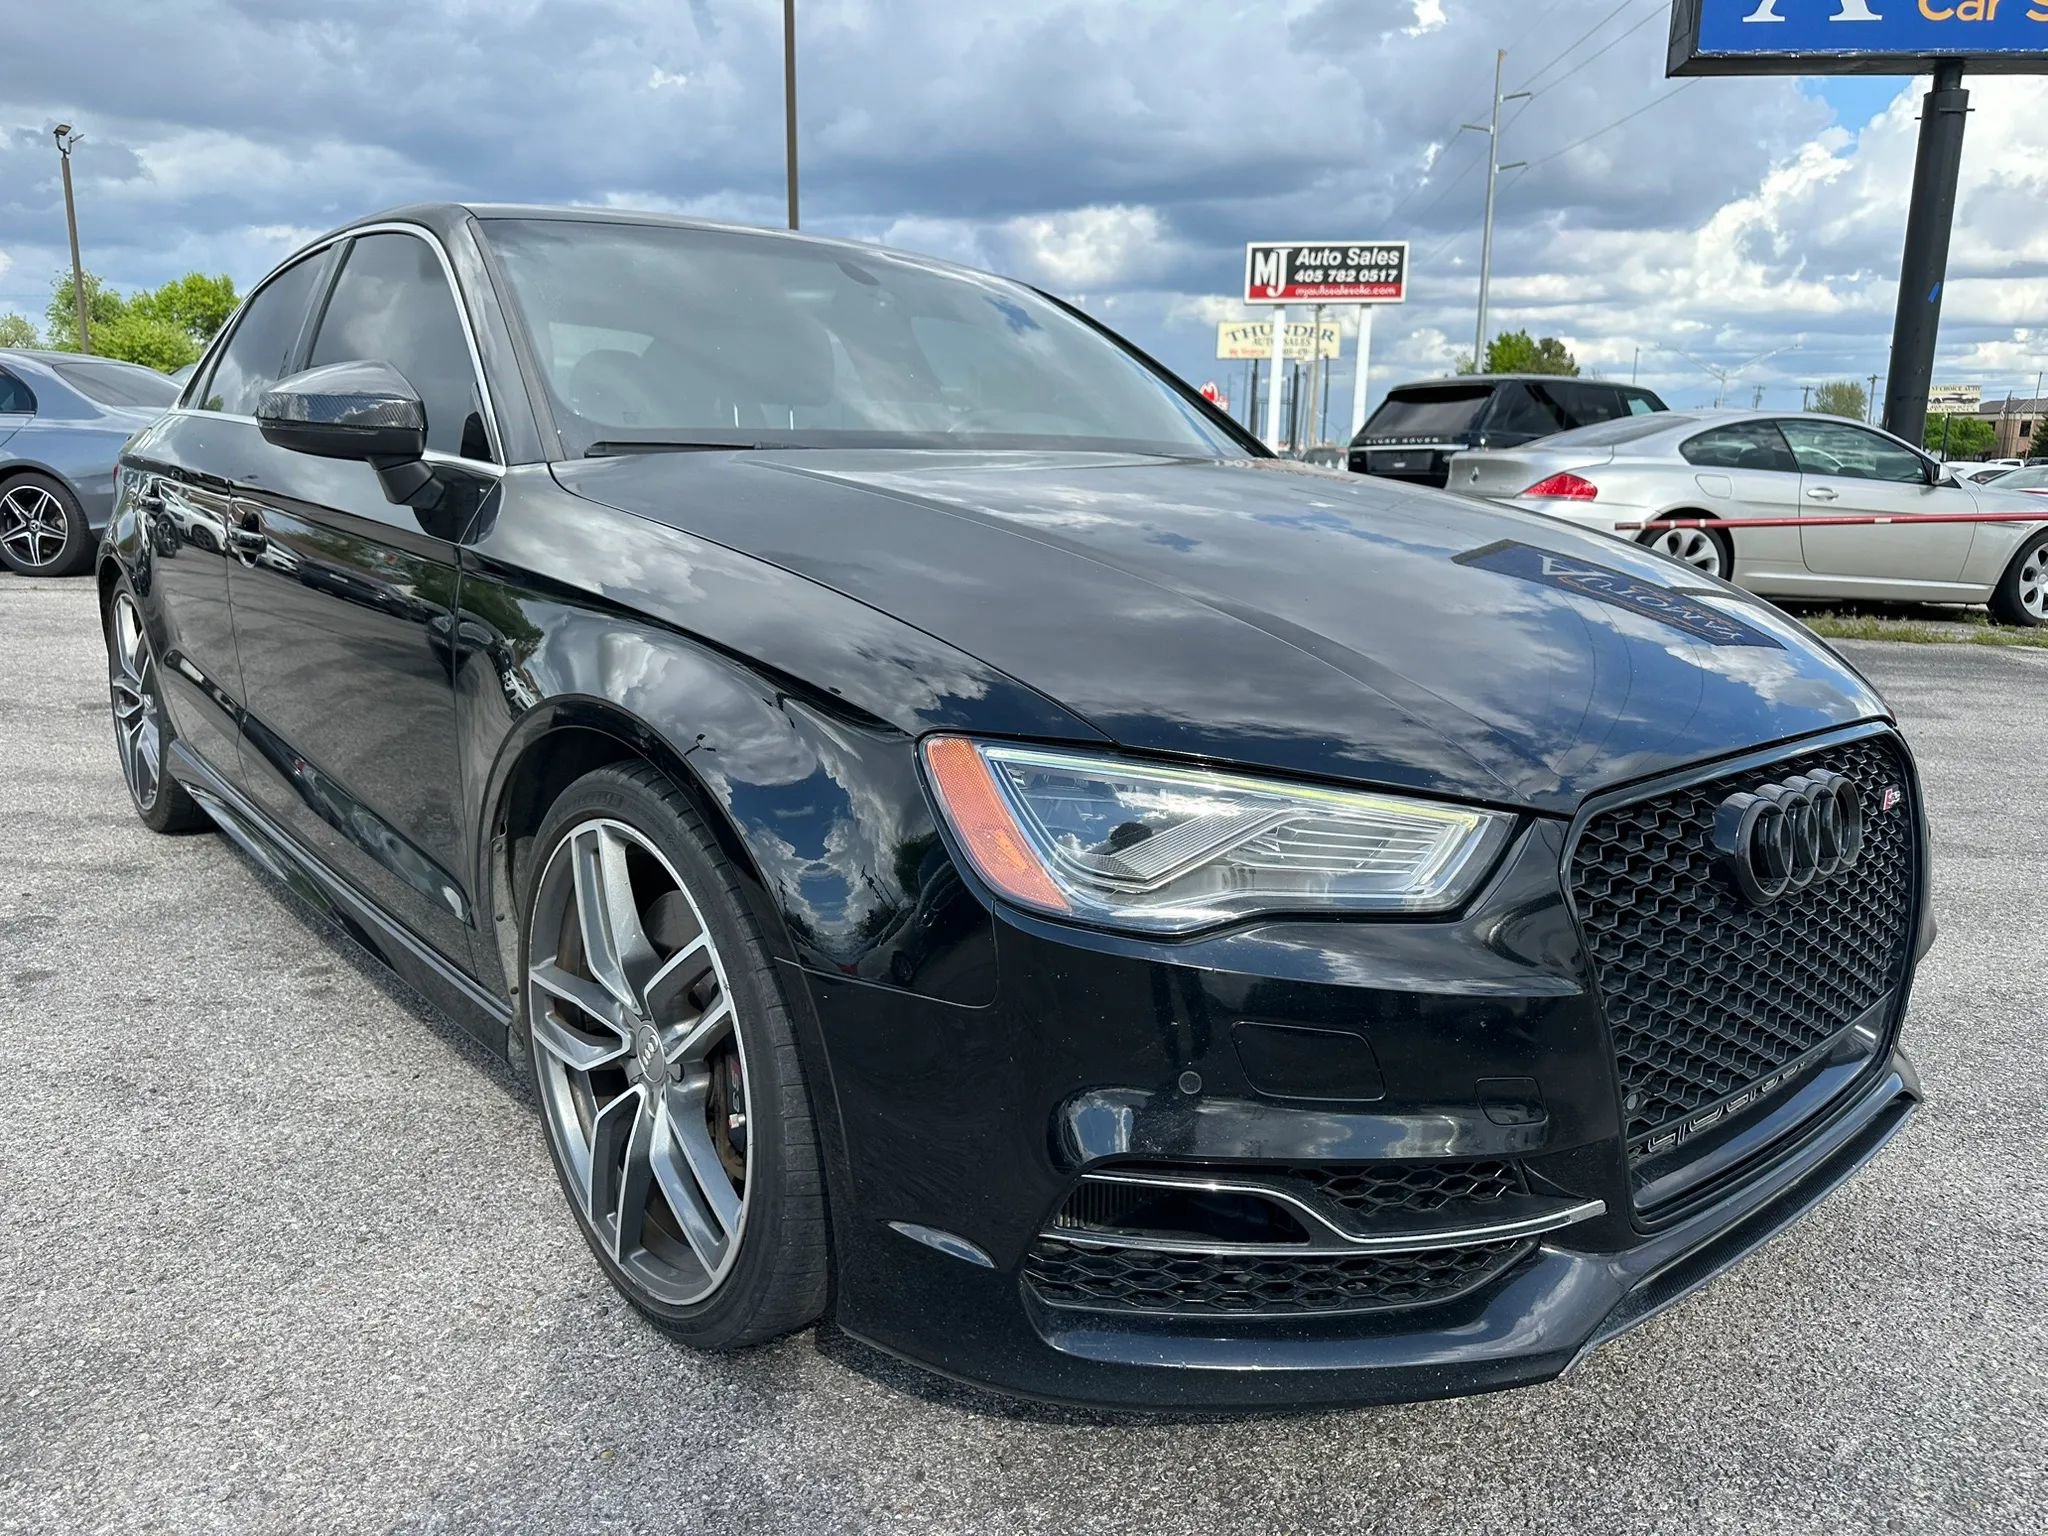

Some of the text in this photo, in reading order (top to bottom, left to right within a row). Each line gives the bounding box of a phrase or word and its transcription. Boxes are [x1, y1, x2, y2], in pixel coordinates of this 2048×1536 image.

[1918, 0, 1999, 21] Car
[1295, 247, 1400, 266] Auto Sales
[1253, 248, 1294, 298] MJ
[1294, 268, 1398, 283] 405 782 0517
